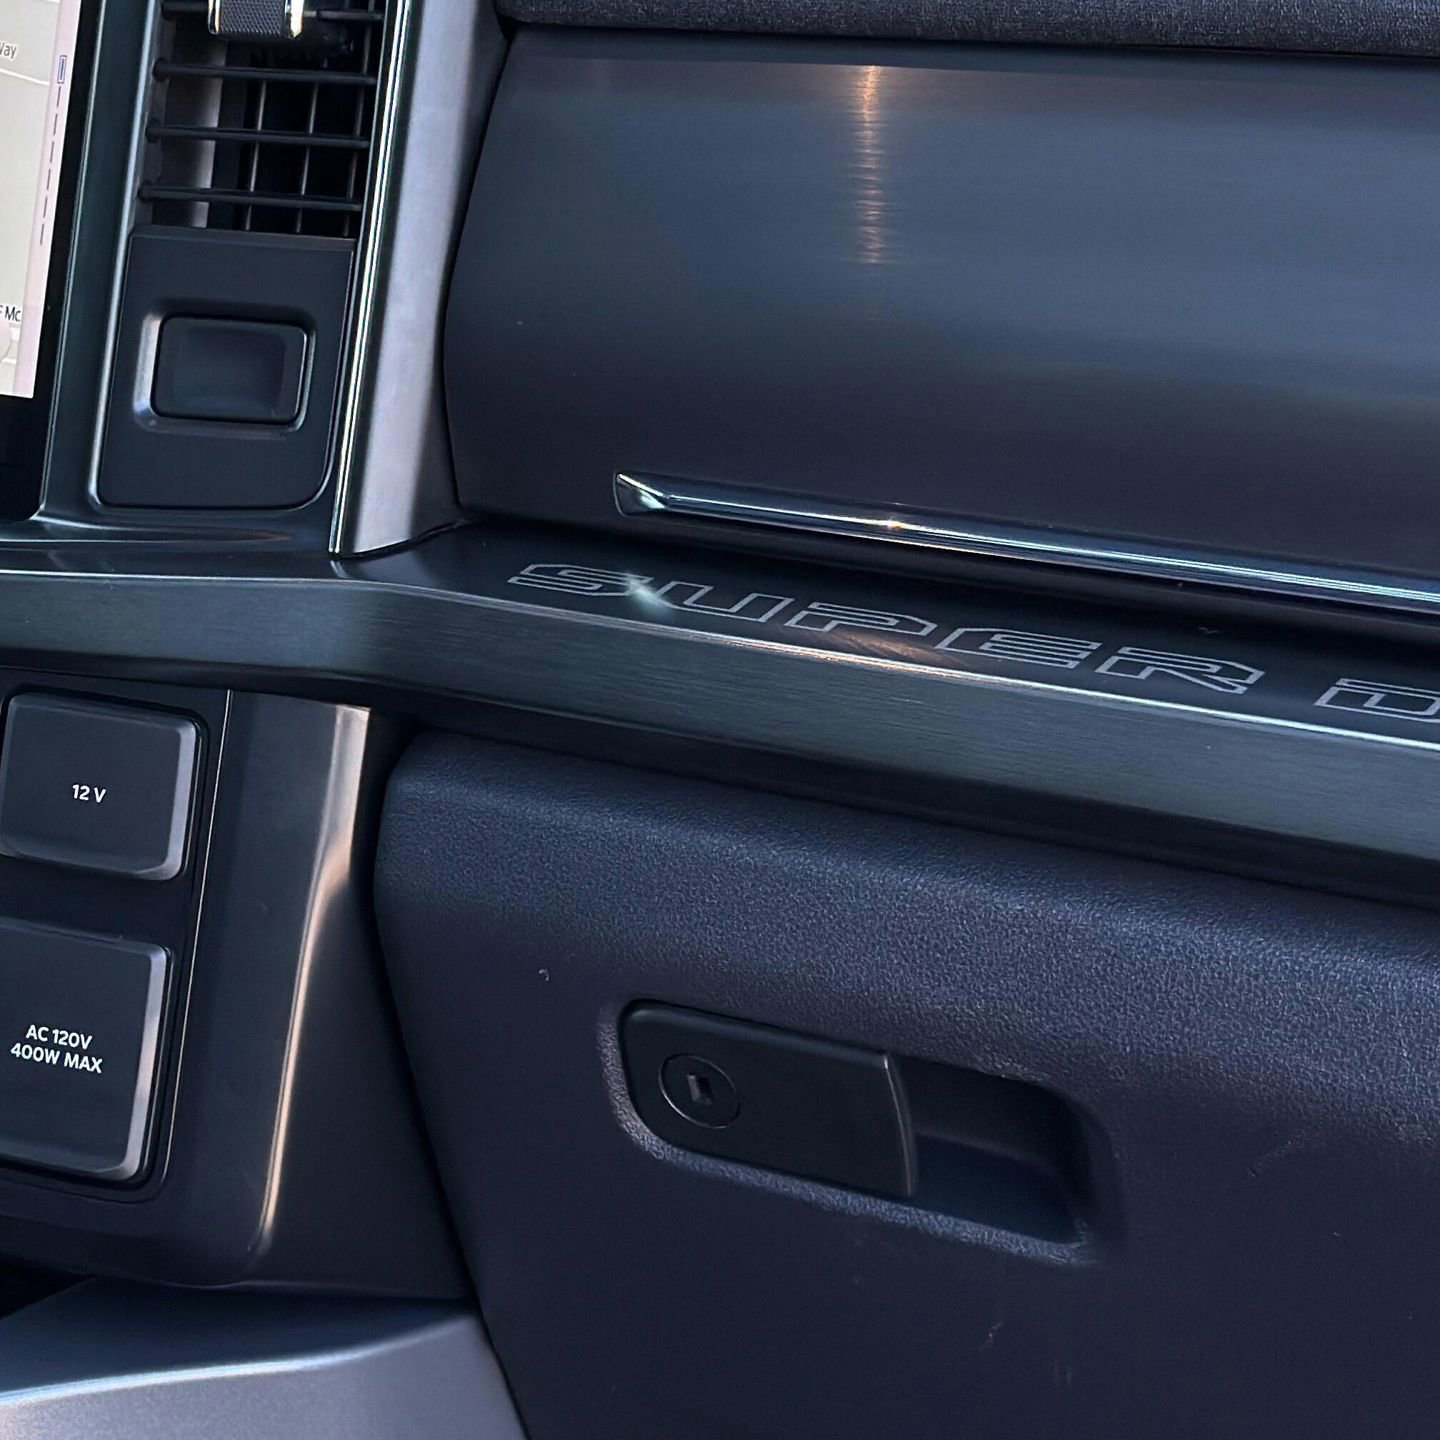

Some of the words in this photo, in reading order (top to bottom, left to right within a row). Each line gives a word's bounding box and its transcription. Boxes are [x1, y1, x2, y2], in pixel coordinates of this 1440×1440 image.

[507, 563, 1266, 695] SUPER
[72, 783, 91, 802] 12
[93, 786, 108, 804] V
[25, 1024, 49, 1043] AC
[52, 1028, 93, 1051] 120V
[11, 1042, 60, 1066] 400W
[63, 1050, 104, 1075] MAX
